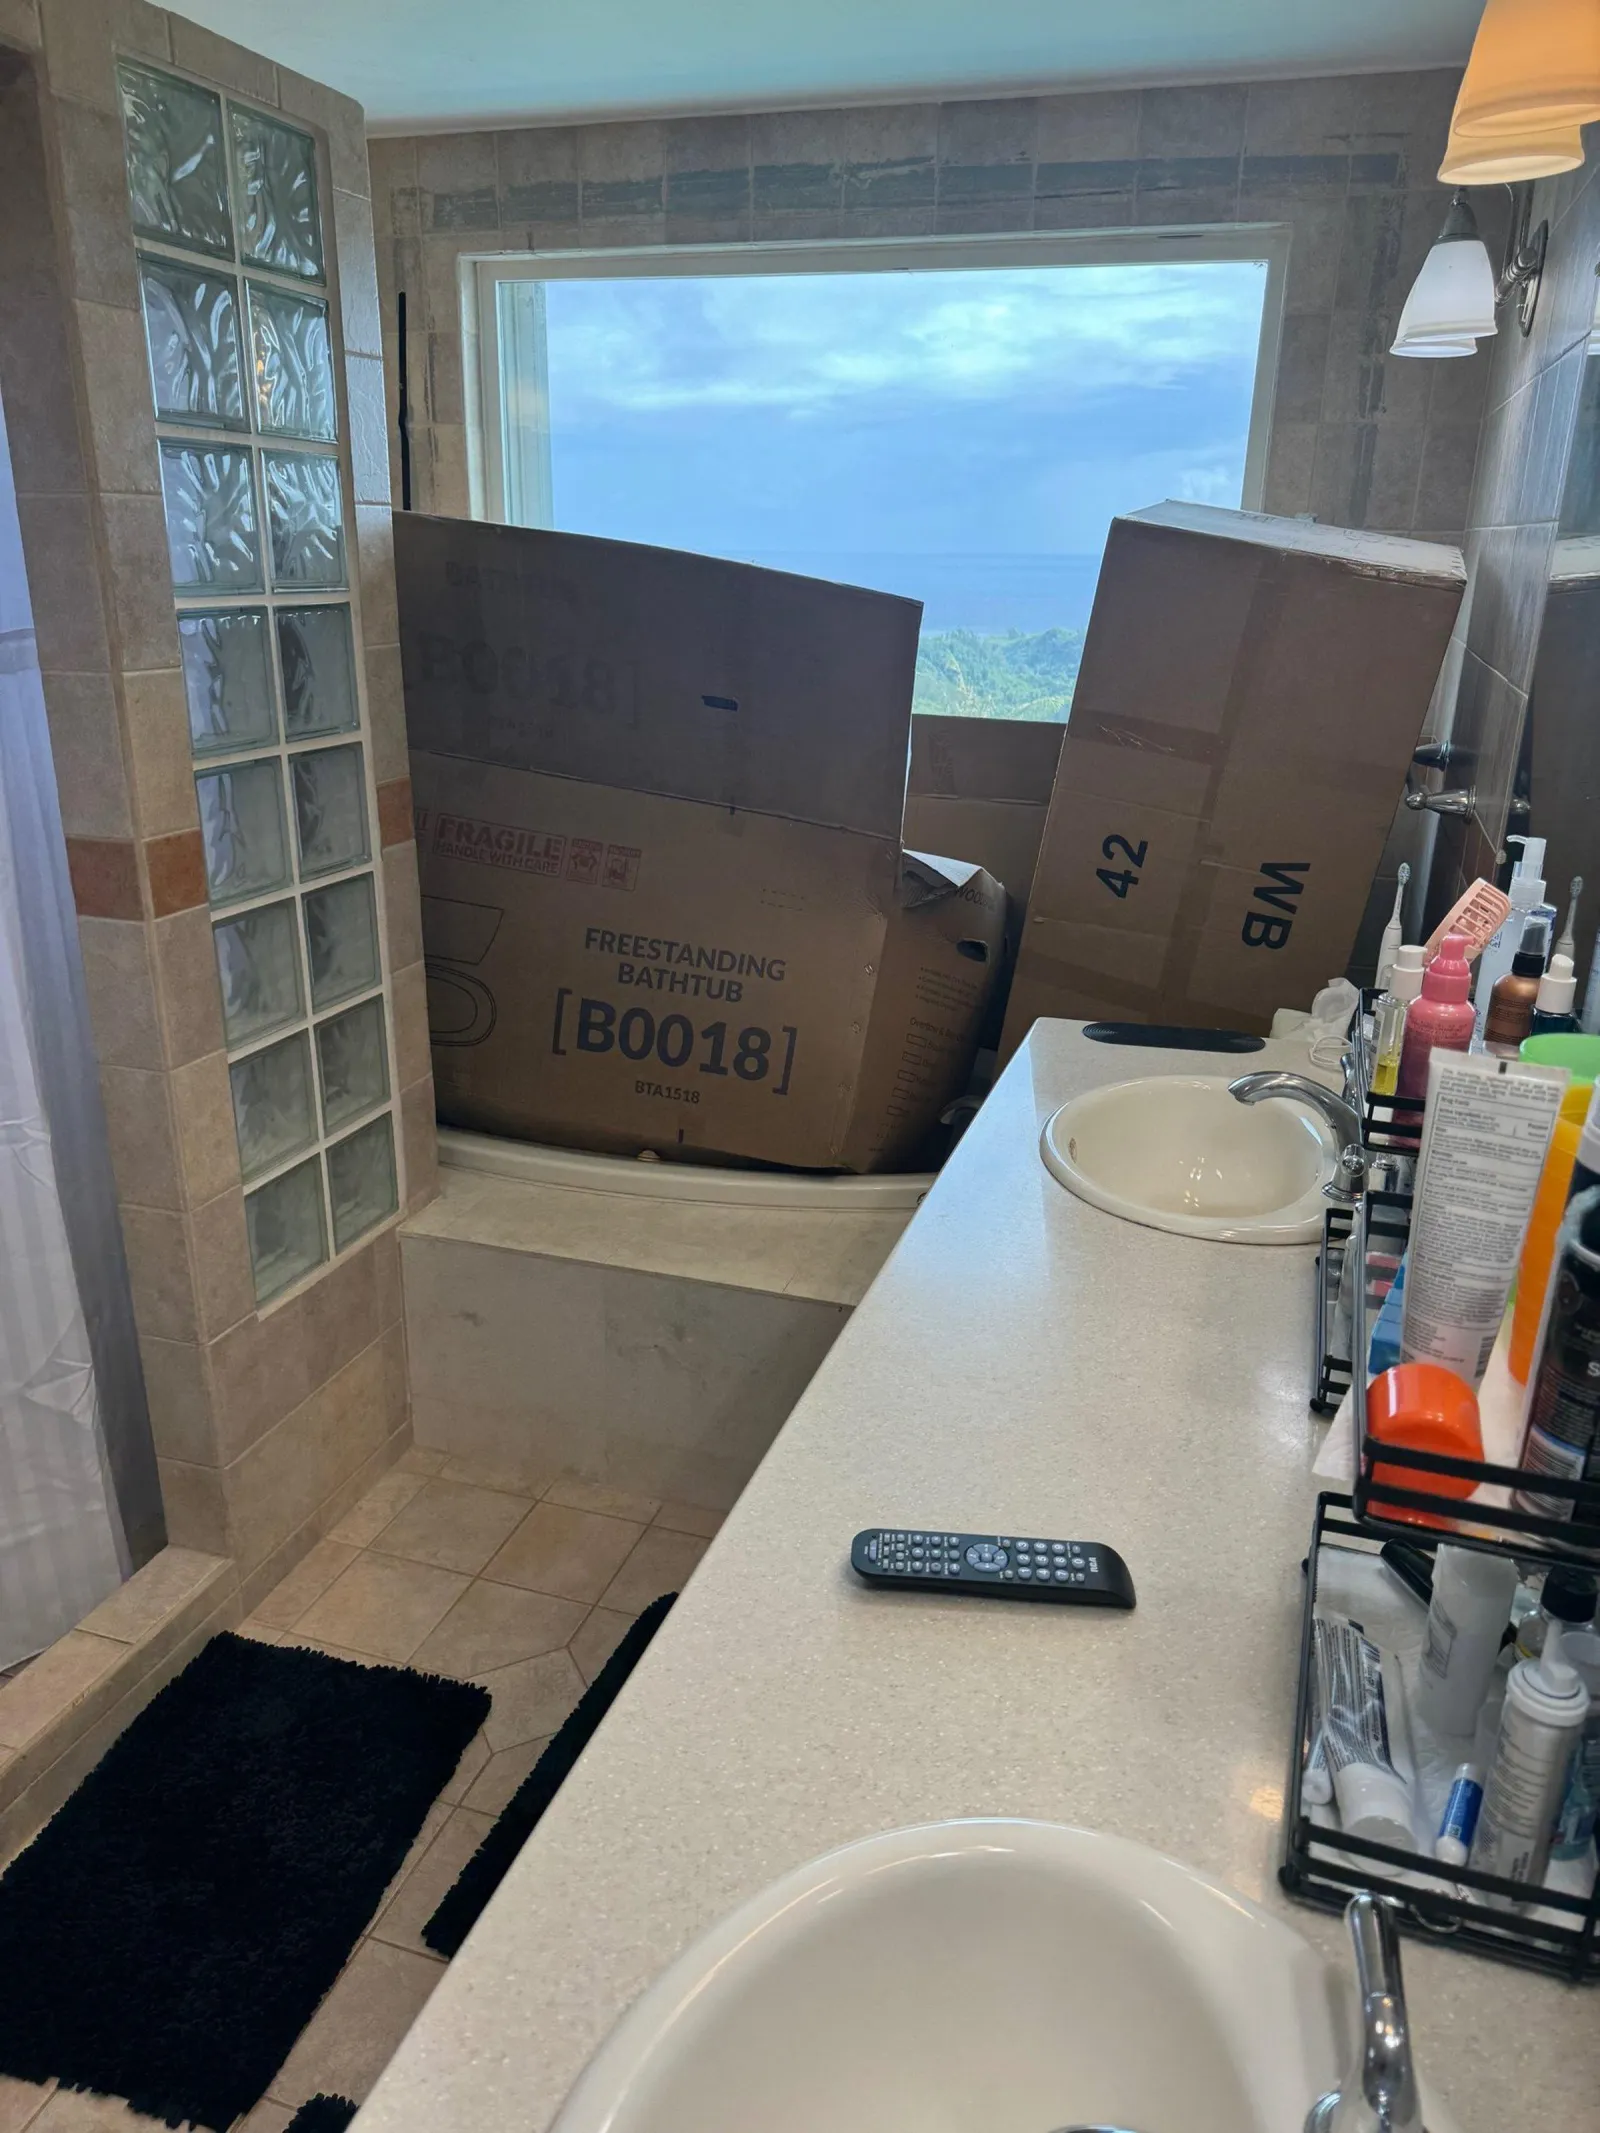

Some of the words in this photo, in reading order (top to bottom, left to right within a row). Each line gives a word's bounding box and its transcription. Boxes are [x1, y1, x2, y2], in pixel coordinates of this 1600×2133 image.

[438, 817, 562, 861] FRAGILE
[523, 856, 559, 875] CARE
[1096, 833, 1149, 898] 42
[1242, 862, 1312, 950] WB
[584, 927, 787, 982] FREESTANDING
[617, 962, 745, 1002] BATHTUB
[552, 987, 798, 1096] [B0018]
[634, 1080, 701, 1105] BTA1518
